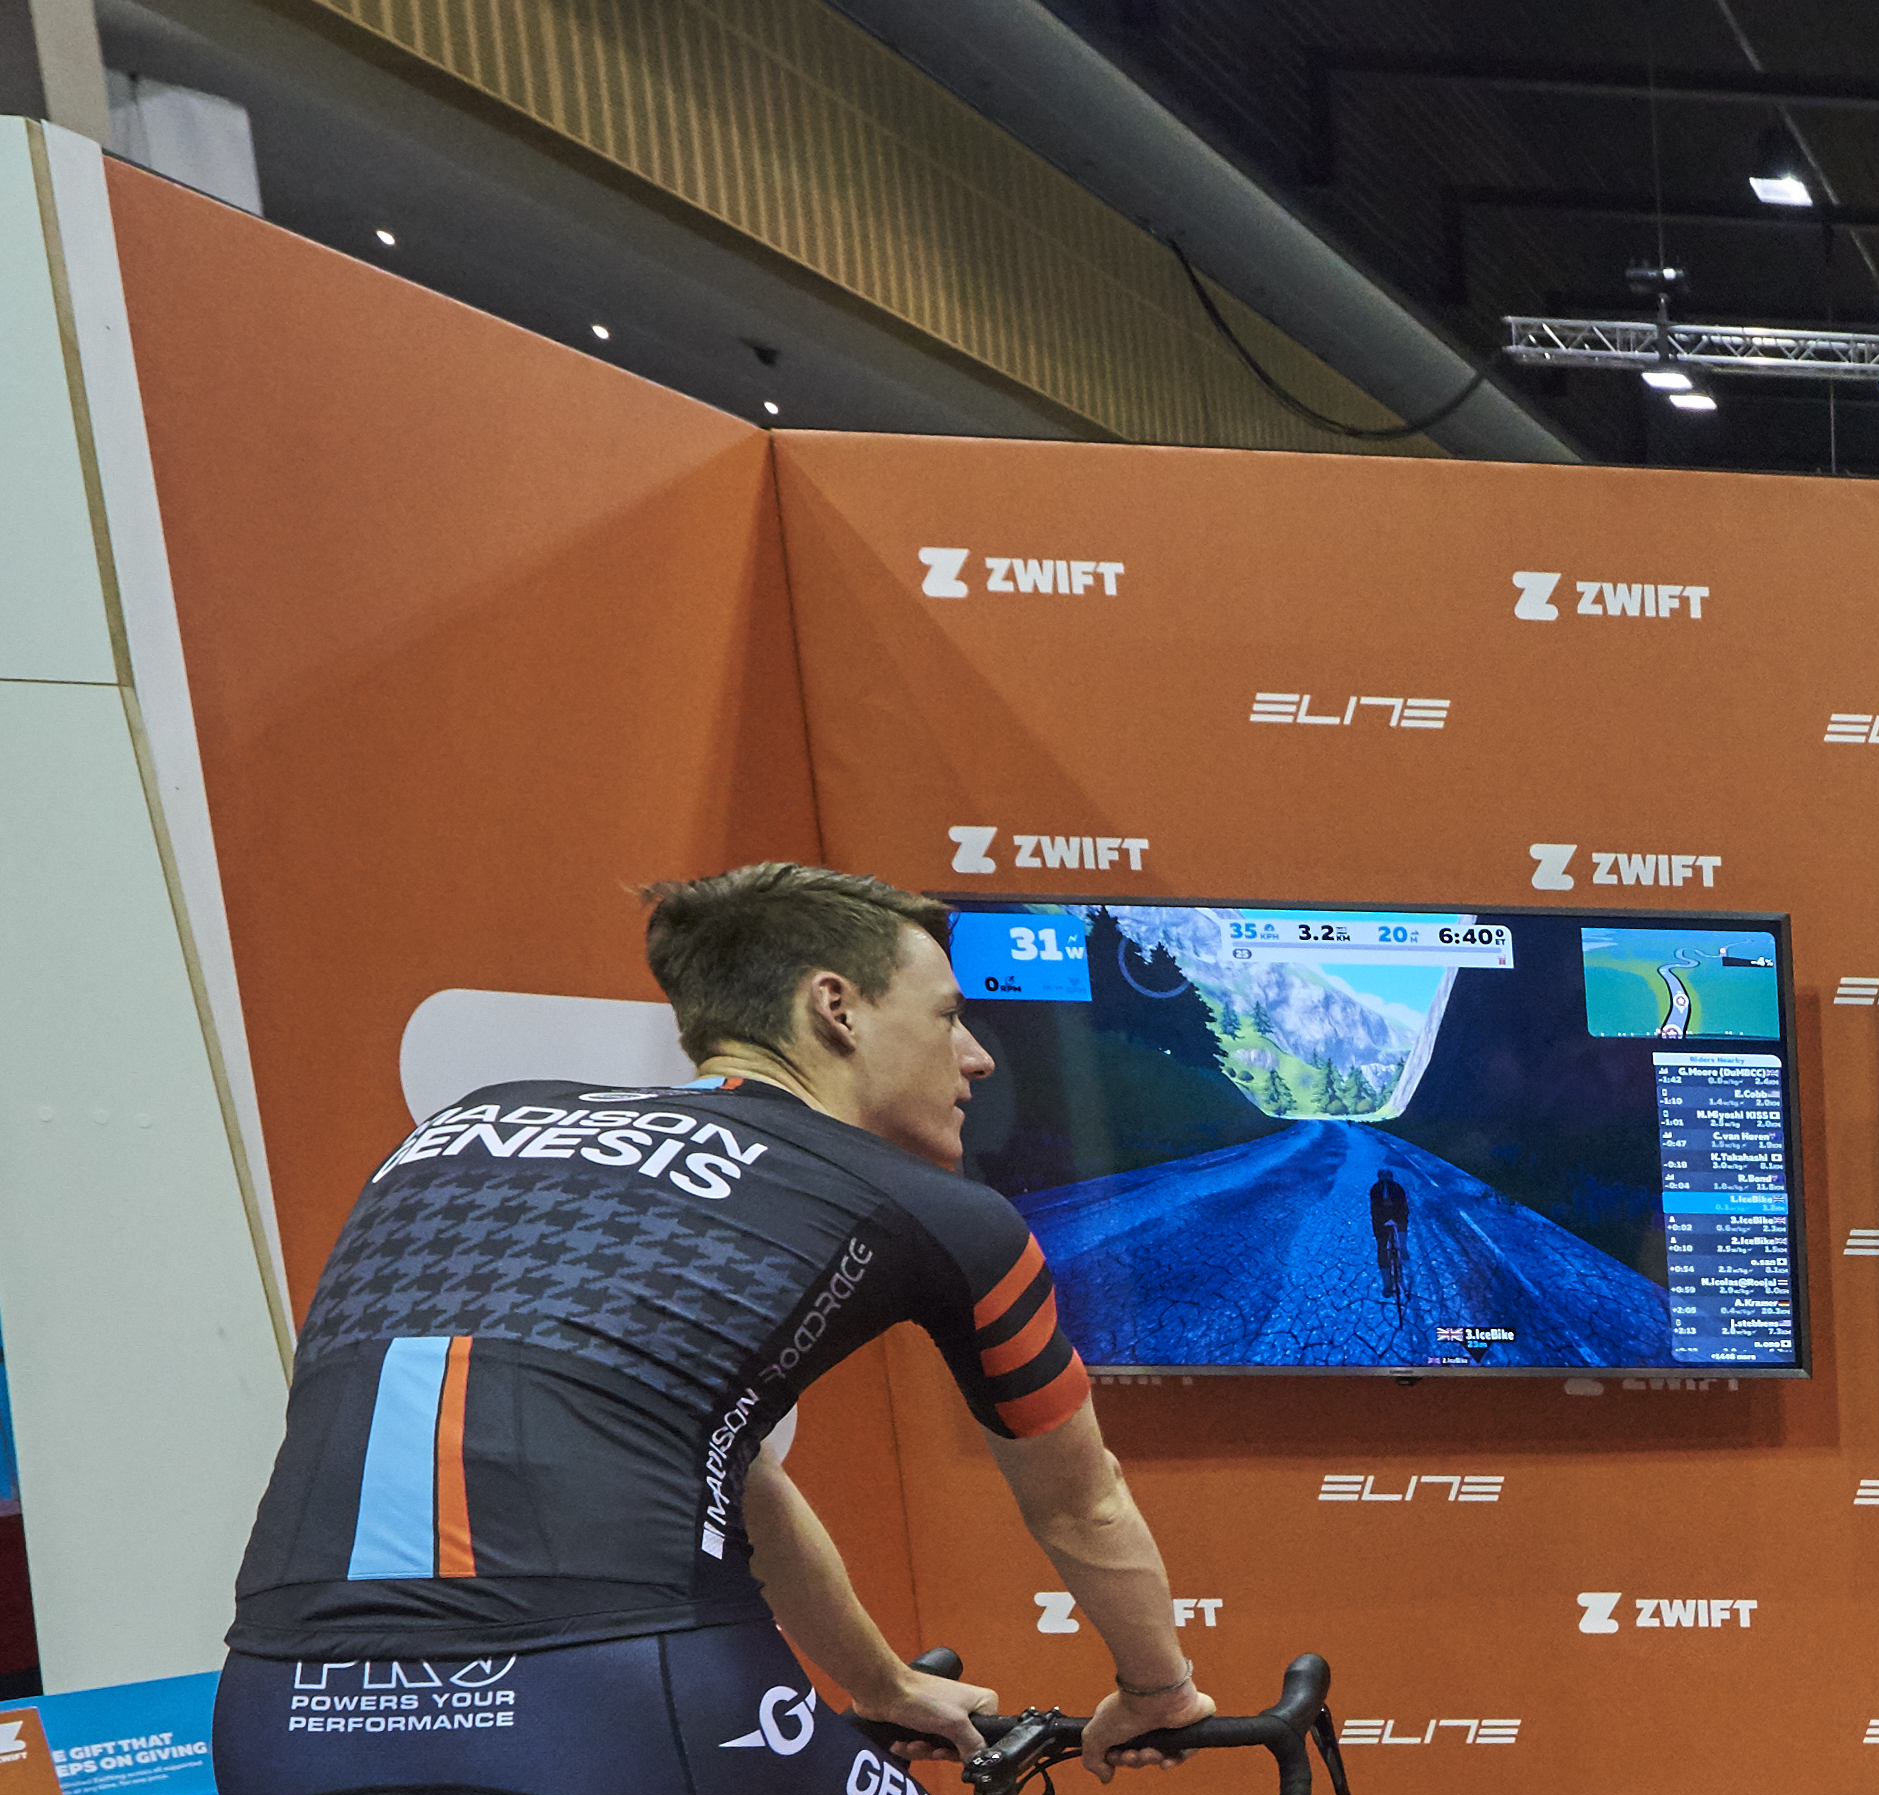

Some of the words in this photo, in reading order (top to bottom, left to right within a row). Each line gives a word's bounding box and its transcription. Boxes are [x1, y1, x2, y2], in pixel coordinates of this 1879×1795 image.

[985, 558, 1124, 596] ZWIFT
[1576, 582, 1709, 619] ZWIFT
[1250, 693, 1450, 728] ELITE
[1013, 836, 1149, 870] ZWIFT
[1592, 853, 1722, 887] ZWIFT
[1008, 927, 1062, 961] 31
[1229, 923, 1257, 939] 35
[1260, 933, 1279, 941] KPH
[1298, 925, 1334, 942] 3.2
[1378, 926, 1407, 943] 20
[1438, 927, 1493, 945] 6:40
[985, 976, 998, 992] 0
[372, 1123, 742, 1200] GENESIS
[1465, 1328, 1514, 1341] 3.IceBike
[703, 1387, 760, 1527] MADISON
[1319, 1476, 1504, 1501] ELITE
[1635, 1600, 1758, 1627] ZWIFT
[291, 1695, 418, 1711] POWERS
[432, 1690, 516, 1708] YOUR
[289, 1711, 515, 1733] PERFORMANCE
[1338, 1720, 1521, 1744] ELITE
[69, 1739, 116, 1761] GIFT
[118, 1732, 174, 1750] THAT
[100, 1755, 134, 1772] ON
[136, 1741, 209, 1765] GIVING
